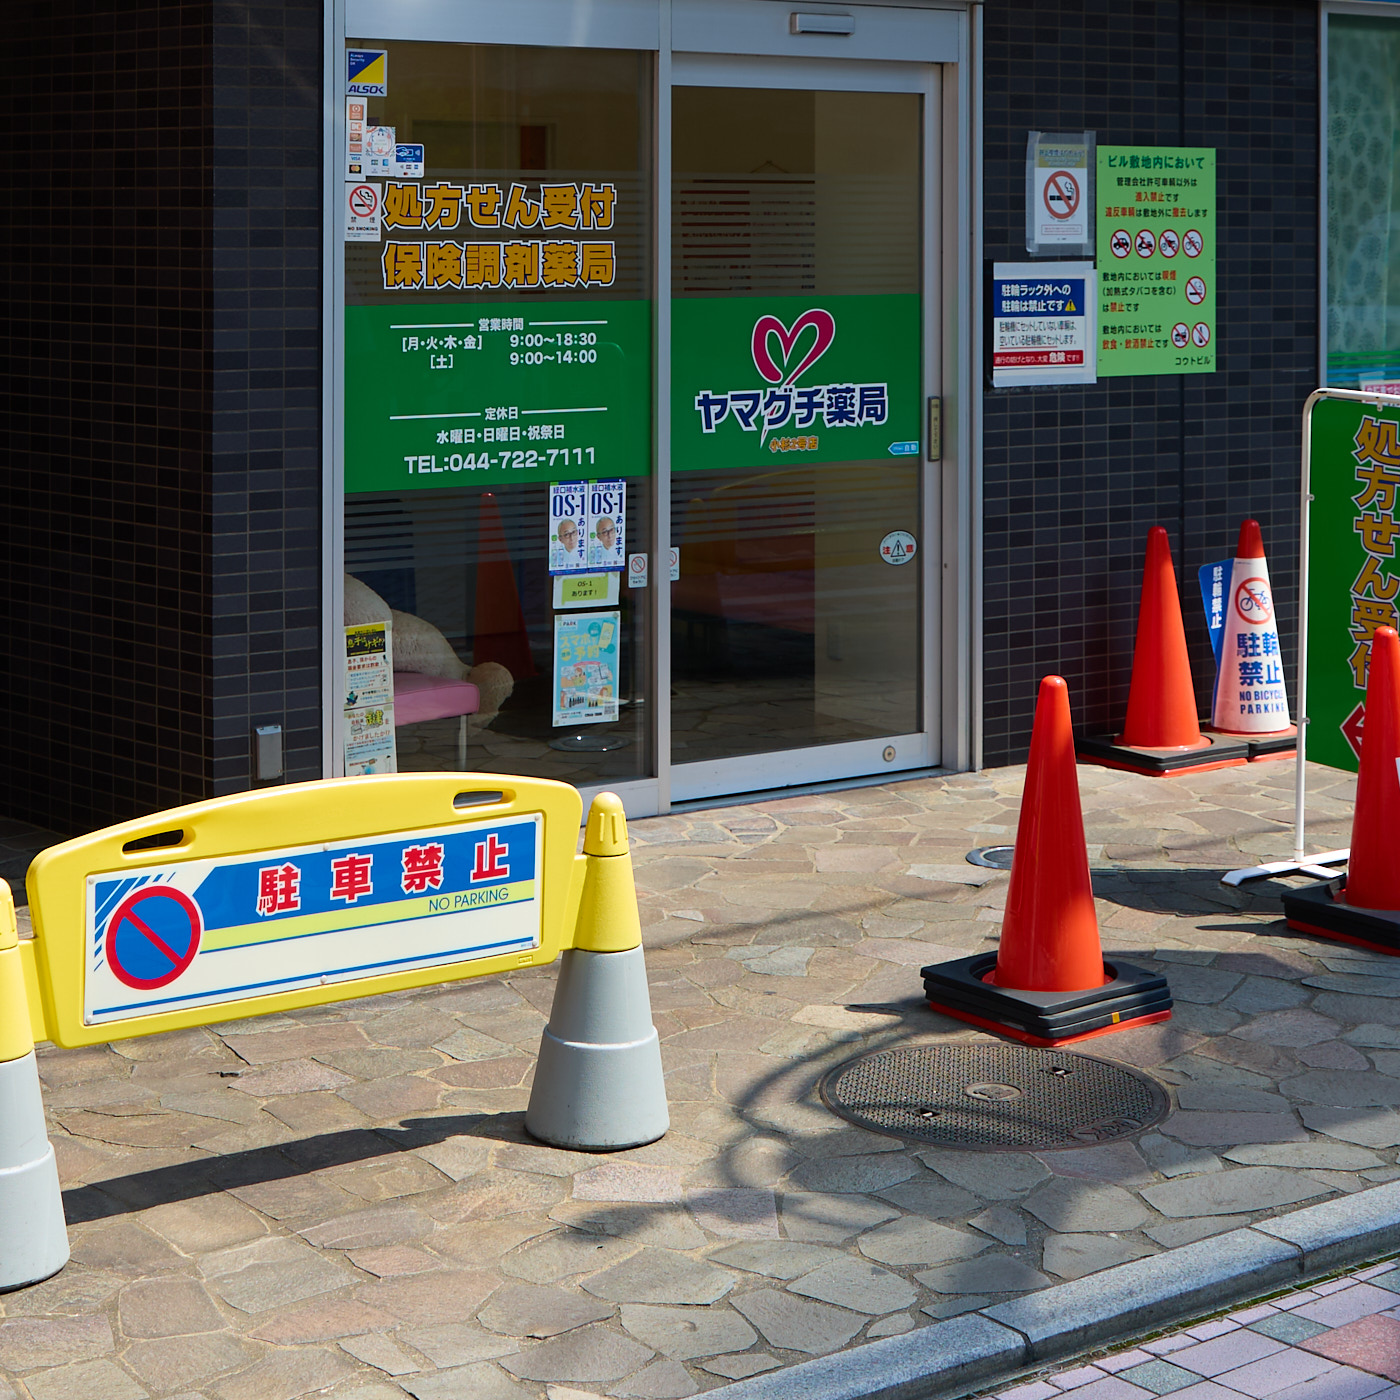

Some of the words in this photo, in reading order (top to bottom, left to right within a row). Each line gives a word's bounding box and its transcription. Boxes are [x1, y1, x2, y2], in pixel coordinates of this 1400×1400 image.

[348, 85, 385, 95] ALSOK
[1108, 155, 1205, 169] ビル敷地内において
[381, 181, 617, 231] 処方せん受付
[381, 240, 616, 290] 保険調剤薬局
[1001, 284, 1072, 297] 駐輪ラック外への
[1001, 299, 1065, 313] 駐輪は禁止です
[1102, 302, 1140, 312] は禁止です
[478, 318, 524, 331] 営業時間
[1102, 324, 1162, 335] 敷地内においては
[430, 354, 454, 369] [土]
[1049, 352, 1066, 363] 危険
[1174, 356, 1211, 366] コウトビル
[484, 407, 519, 420] 定休日
[695, 383, 888, 434] ヤマグチ薬局
[436, 425, 566, 445] 水曜日・日曜日・祝祭日
[404, 447, 596, 475] TEL:044-722-7111
[553, 486, 585, 494] 経口補水液
[592, 484, 623, 492] 経口補水液
[553, 493, 585, 517] OS-1
[591, 492, 623, 515] OS-1
[1210, 565, 1223, 630] 駐輪禁止
[1236, 631, 1279, 658] 駐輪
[1238, 660, 1282, 687] 禁止
[1239, 690, 1252, 702] NO
[255, 832, 512, 917] 駐車禁止
[428, 896, 451, 913] NO
[453, 886, 510, 911] PARKING
